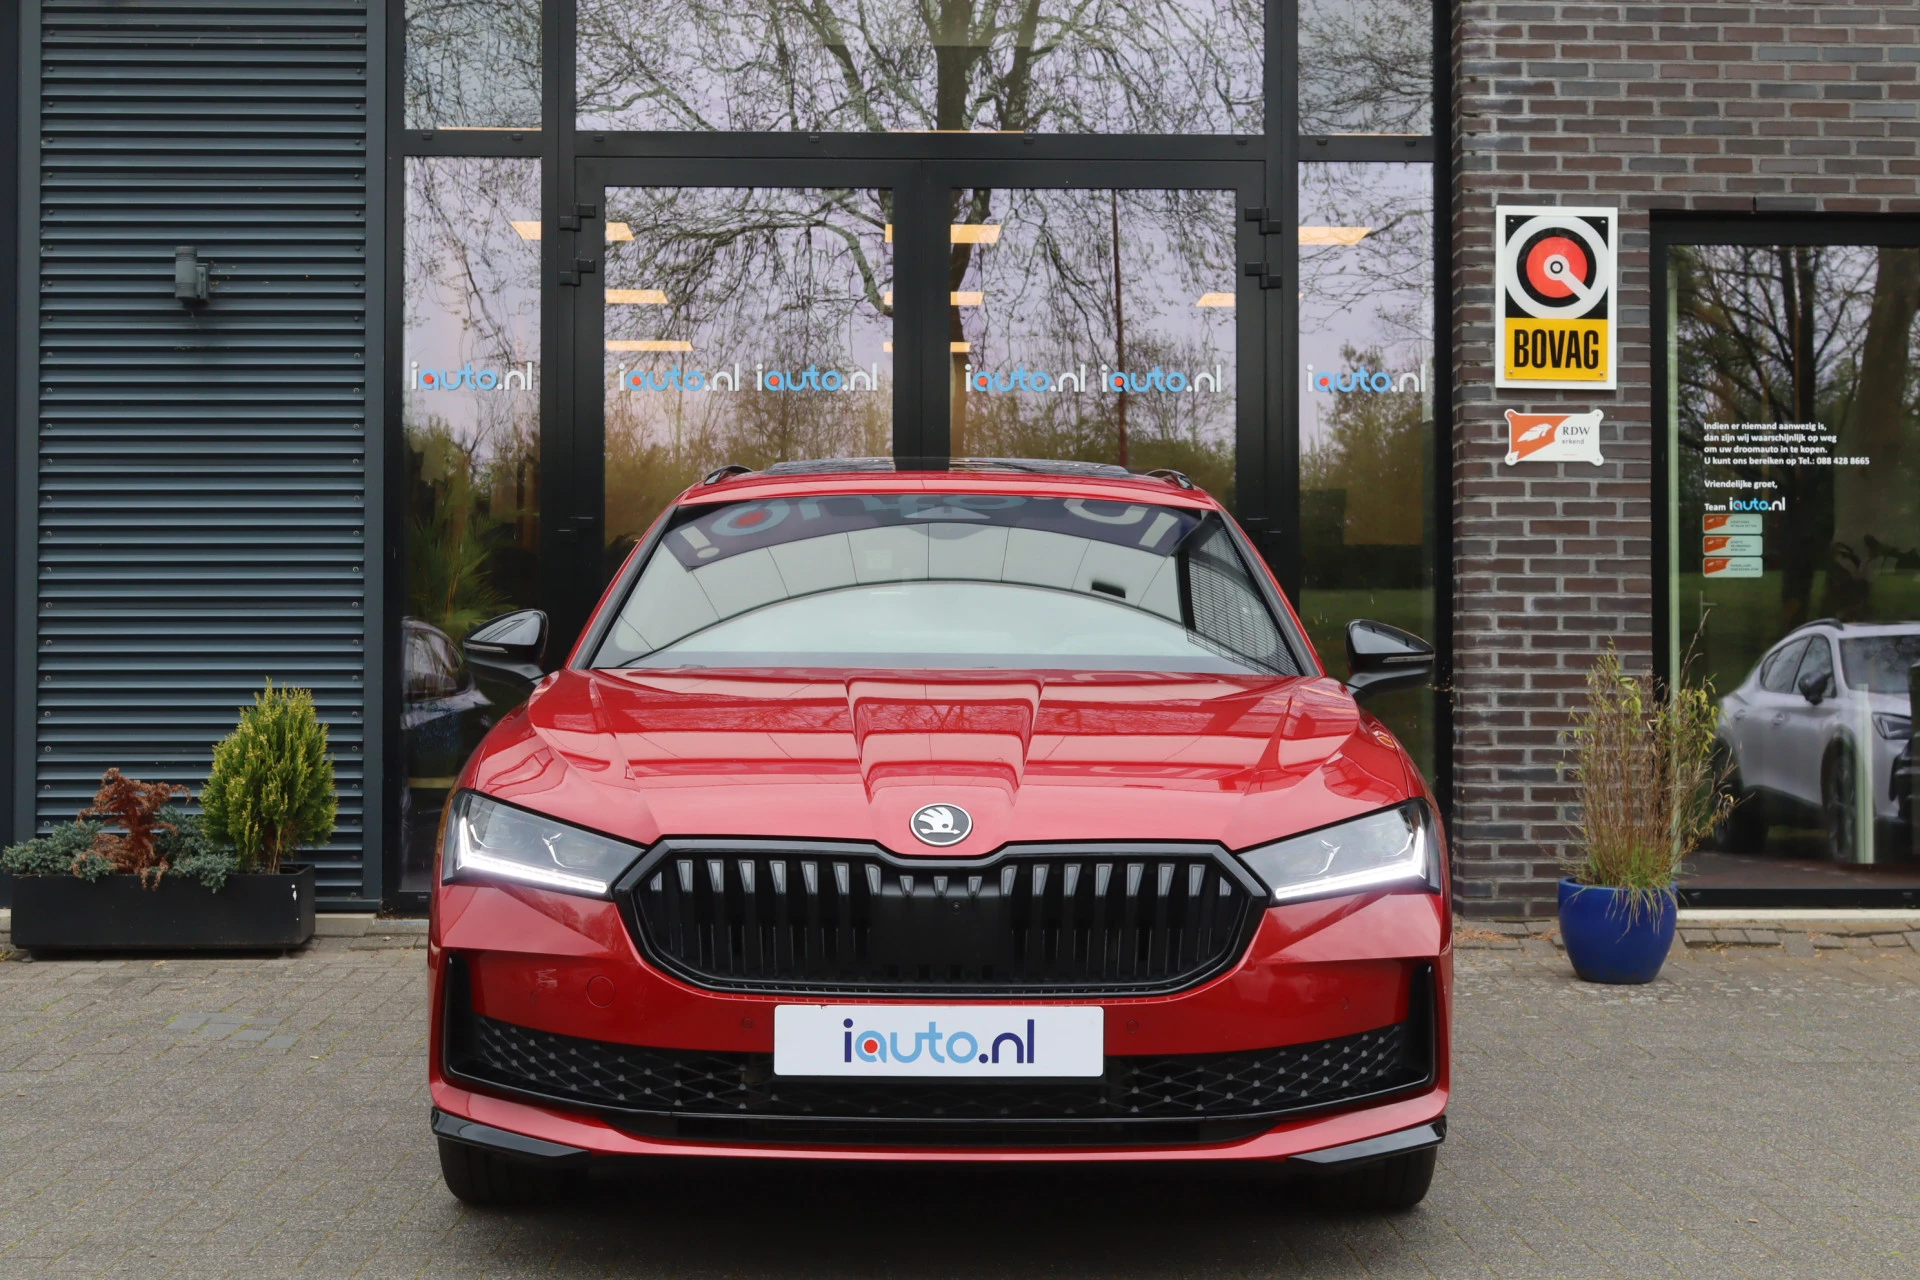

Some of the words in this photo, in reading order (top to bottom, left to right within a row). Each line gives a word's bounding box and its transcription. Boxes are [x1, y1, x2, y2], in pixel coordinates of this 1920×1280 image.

[1514, 329, 1598, 369] BOVAG
[410, 361, 534, 391] iauto.nl
[618, 363, 740, 392] iauto.nl
[756, 363, 878, 392] iauto.nl
[964, 364, 1086, 393] iauto.nl
[1101, 364, 1222, 393] iauto.nl
[1306, 364, 1427, 393] iauto.nl
[1562, 426, 1591, 436] RDW
[1703, 422, 1730, 430] Indien
[1741, 422, 1777, 430] niemand
[1778, 422, 1817, 432] aanwezig
[1817, 422, 1827, 431] is,
[1703, 434, 1720, 442] dan
[1721, 434, 1735, 443] zijn
[1736, 434, 1750, 443] wij
[1751, 434, 1806, 443] waarschijnlijk
[1807, 435, 1819, 443] op
[1820, 435, 1837, 443] weg
[1733, 445, 1779, 453] droomauto
[1780, 445, 1789, 453] in
[1800, 445, 1828, 454] kopen.
[1704, 457, 1711, 465] U
[1712, 457, 1731, 465] kunt
[1749, 457, 1784, 465] bereiken
[1798, 457, 1815, 465] Tel.:
[1816, 457, 1832, 465] 088
[1833, 457, 1849, 465] 428
[1850, 457, 1870, 465] 8665
[1704, 480, 1752, 489] Vriendelijke
[1753, 480, 1778, 489] groet,
[1704, 503, 1726, 511] Team
[1729, 497, 1786, 511] iauto.nl
[843, 1018, 1034, 1064] iauto.nl
